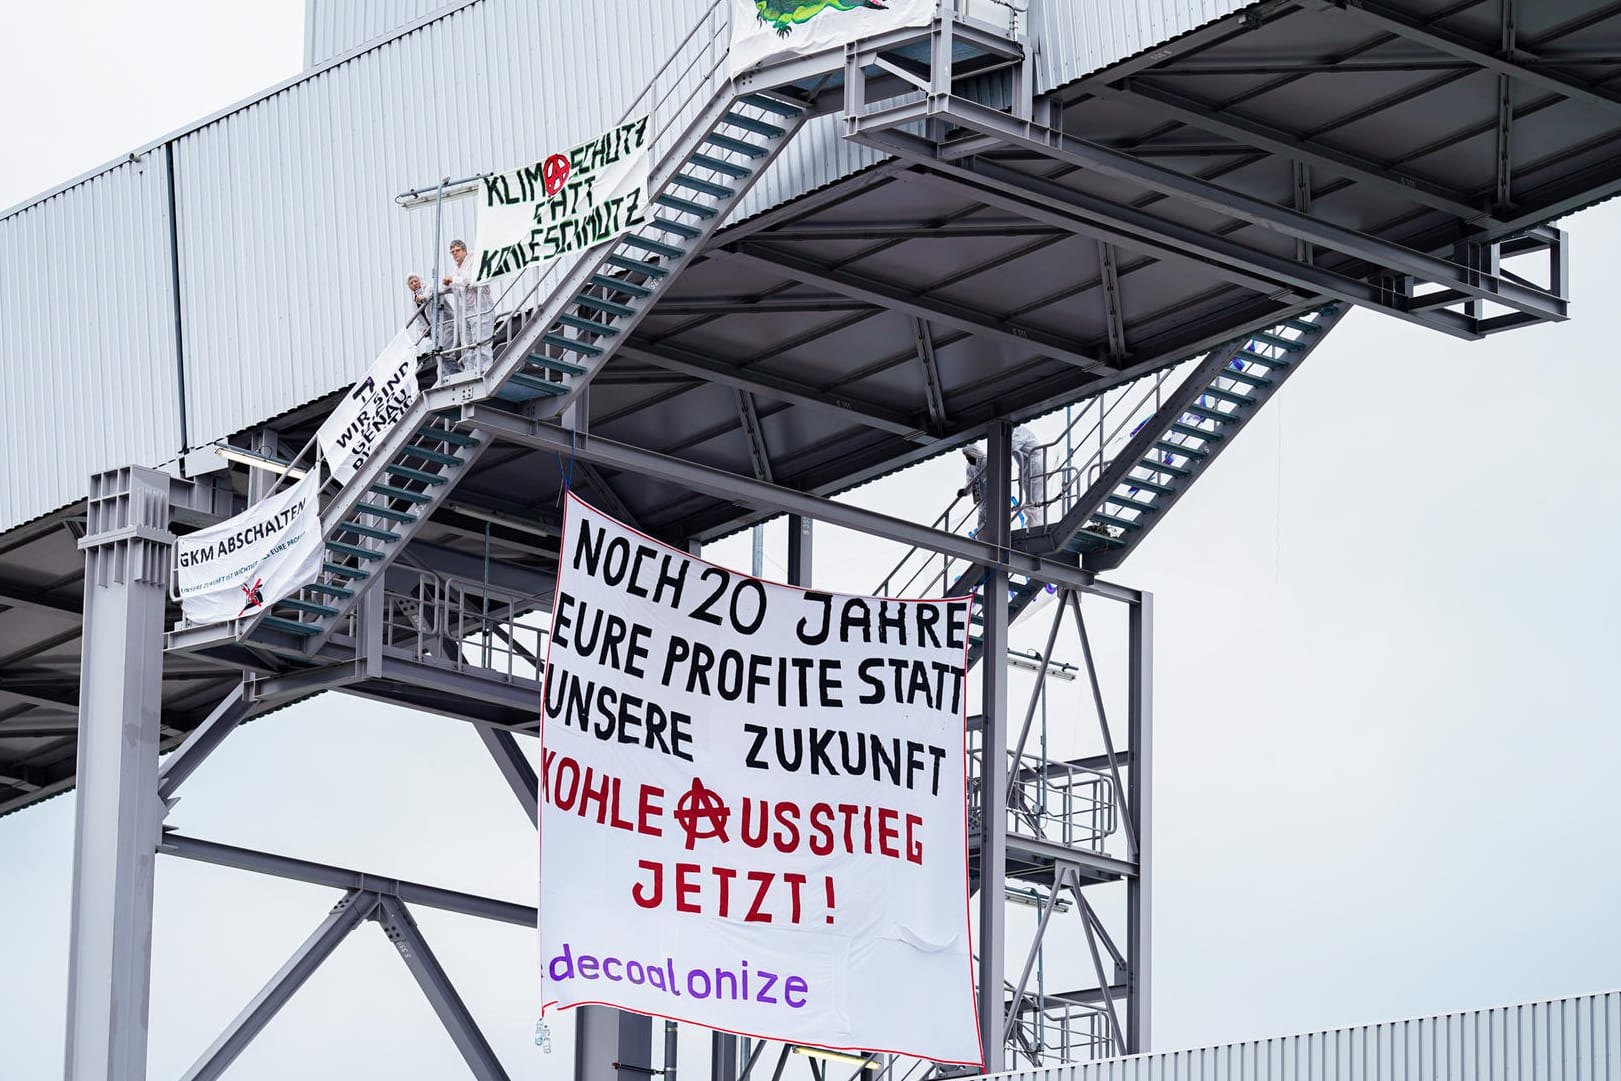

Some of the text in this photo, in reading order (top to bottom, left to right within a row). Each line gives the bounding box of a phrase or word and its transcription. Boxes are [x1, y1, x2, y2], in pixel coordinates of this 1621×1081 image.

[336, 410, 370, 448] WIR
[373, 361, 409, 406] SIND
[352, 389, 408, 455] GENAU
[180, 497, 307, 568] GKM ABSCHALTEN
[270, 544, 287, 555] EURE
[573, 518, 968, 650] NOCH 20 JAHRE
[552, 591, 966, 715] EURE PROFITE STATT
[545, 663, 947, 796] UNSERE ZUKUNFT
[541, 943, 809, 1009] decoalonize
